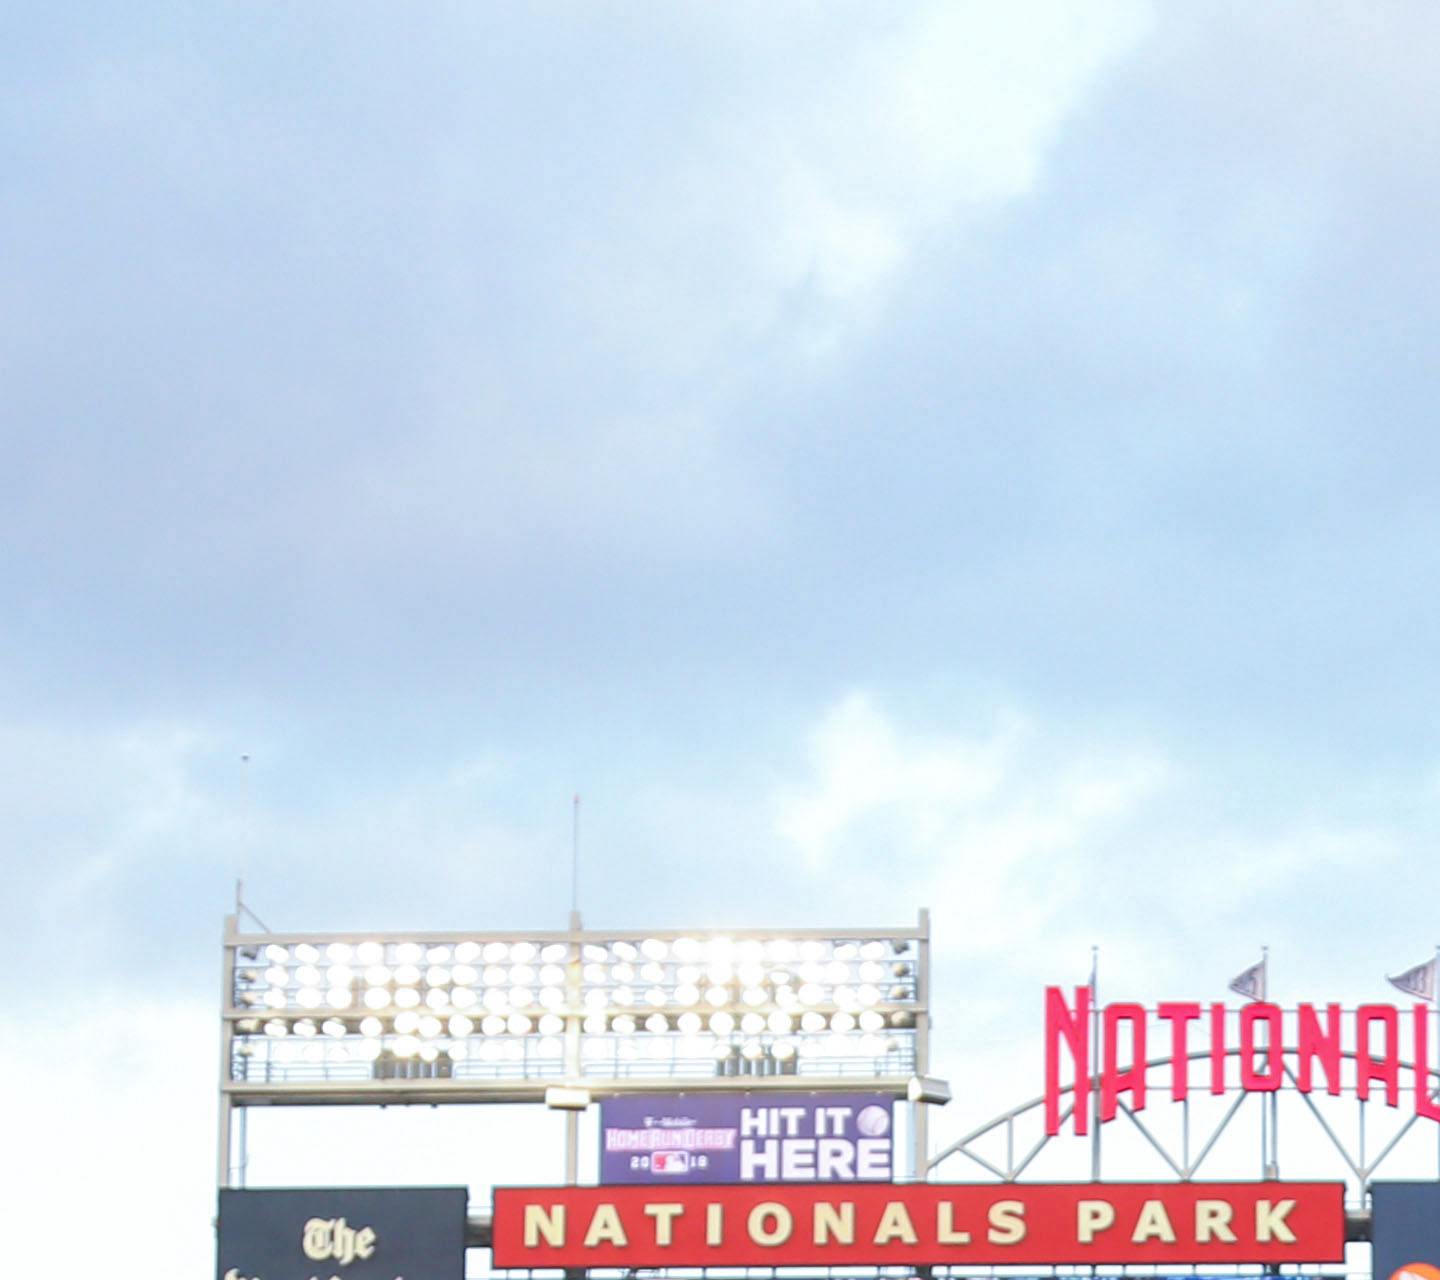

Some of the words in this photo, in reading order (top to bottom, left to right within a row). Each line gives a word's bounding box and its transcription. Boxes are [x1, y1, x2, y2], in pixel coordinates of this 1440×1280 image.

[740, 1107, 806, 1136] HIT
[815, 1107, 852, 1136] IT
[740, 1138, 891, 1180] HERE
[303, 1217, 375, 1265] The
[524, 1199, 1027, 1248] NATIONALS
[1077, 1200, 1298, 1245] PARK
